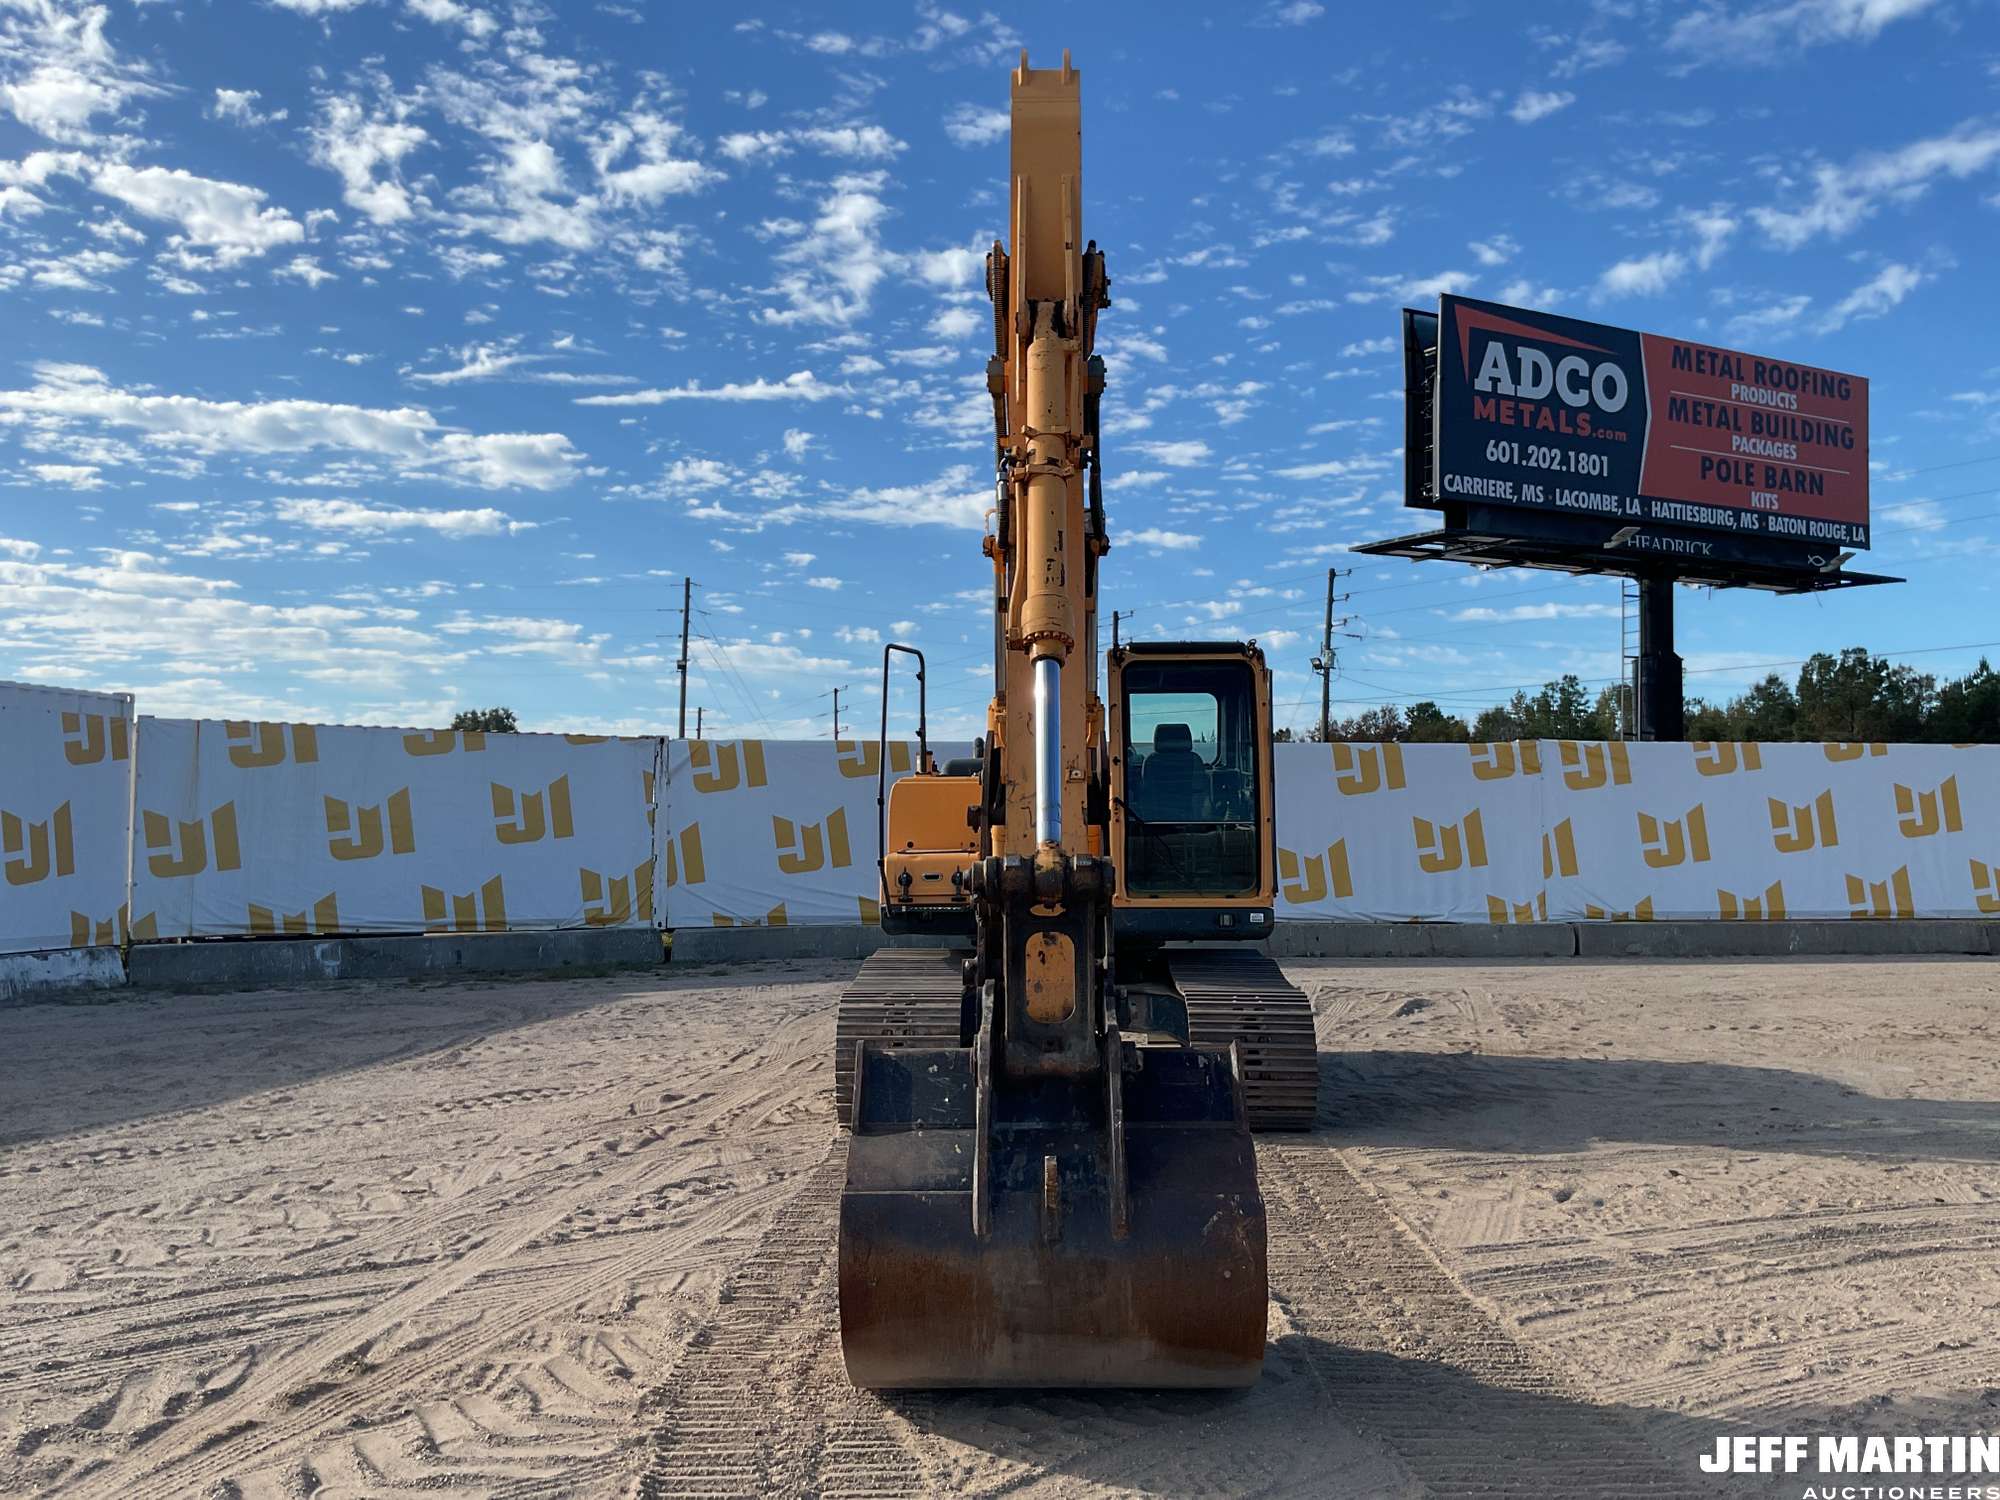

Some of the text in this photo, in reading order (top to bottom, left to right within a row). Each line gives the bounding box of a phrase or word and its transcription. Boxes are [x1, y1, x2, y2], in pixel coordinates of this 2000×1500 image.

[1474, 341, 1628, 413] ADCO
[1671, 345, 1850, 401] METAL ROOFING
[1731, 383, 1797, 410] PRODUCTS
[1668, 397, 1854, 450] METAL BUILDING
[1486, 440, 1608, 477] 601.202.1801
[1731, 435, 1797, 460] PACKAGES
[1701, 456, 1824, 496] POLE BARN
[1444, 474, 1866, 543] CARRIERE, MS LACOMBE, LA HATTIESBURG, MS BATON ROUGE, LA
[1751, 492, 1779, 510] KITS
